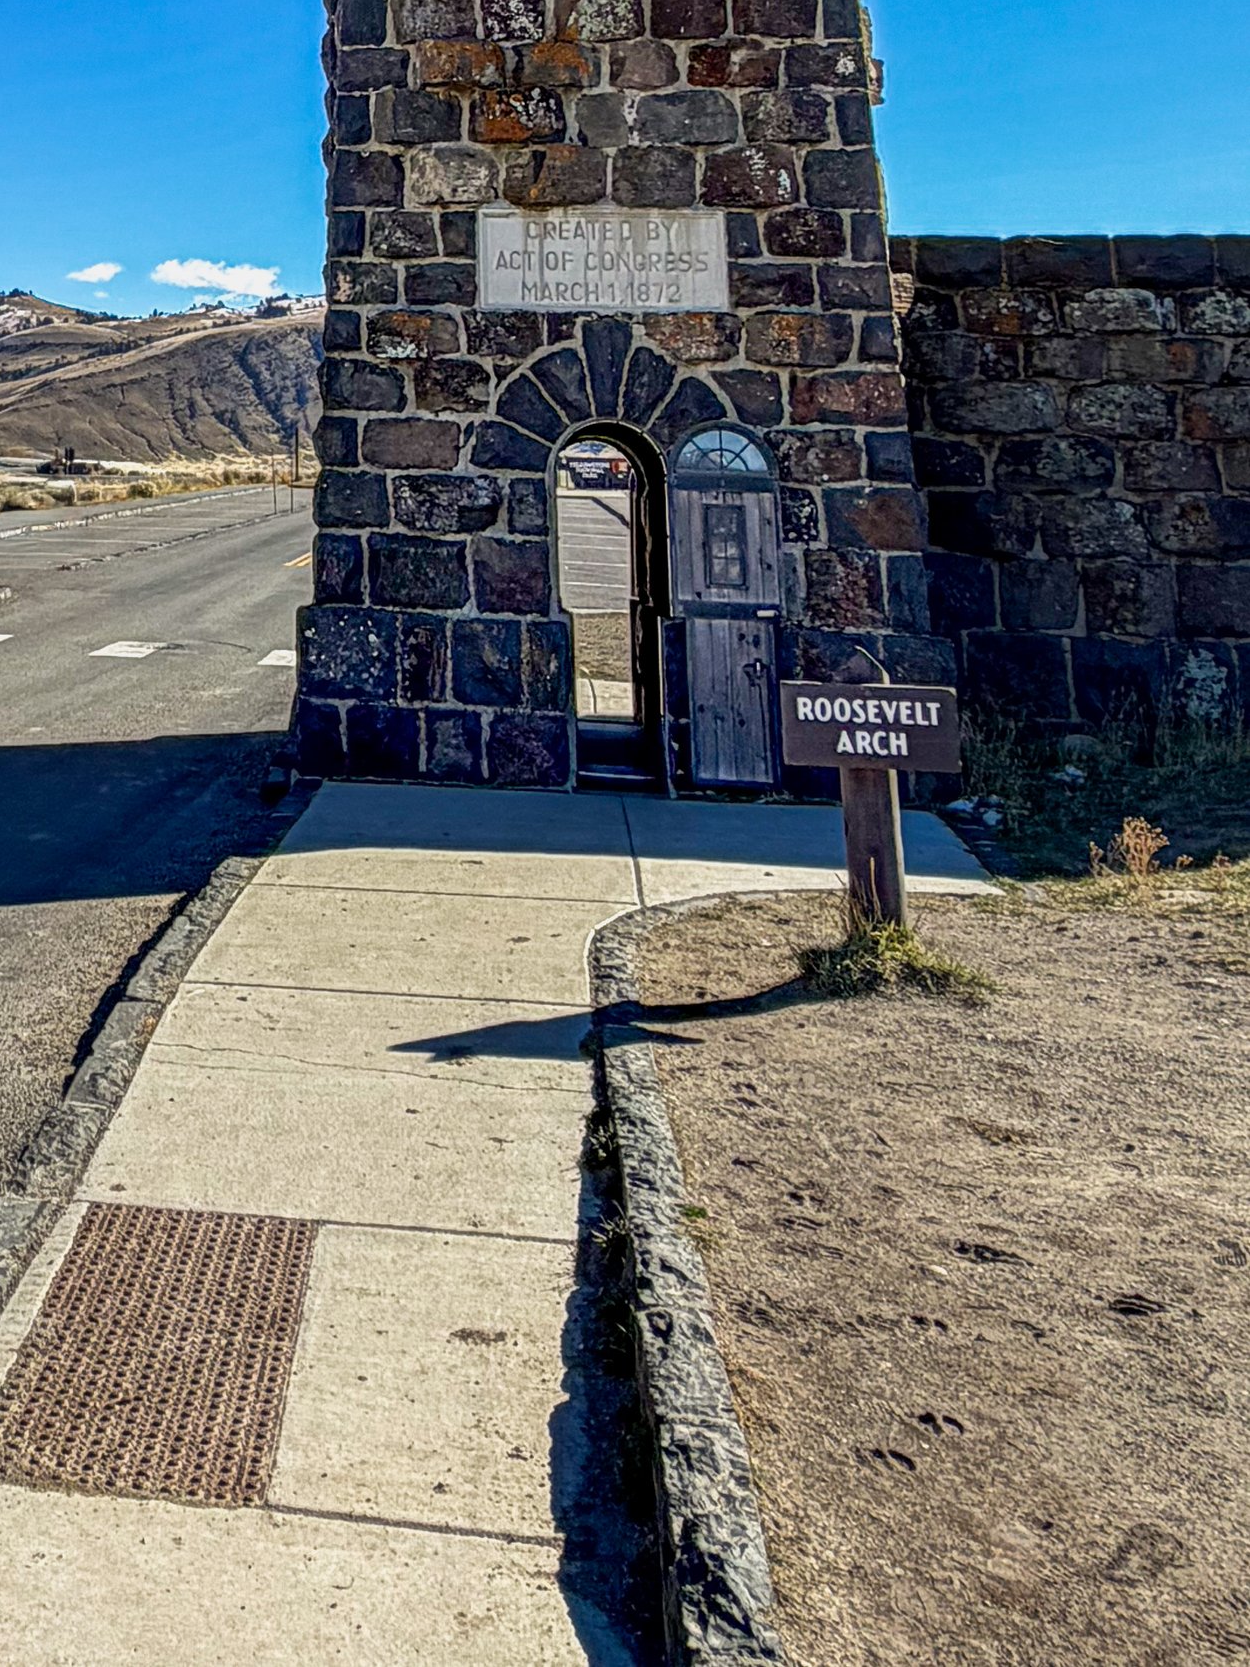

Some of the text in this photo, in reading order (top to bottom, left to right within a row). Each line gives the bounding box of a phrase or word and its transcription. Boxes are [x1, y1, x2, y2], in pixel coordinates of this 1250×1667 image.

[526, 220, 678, 241] CREATED BY
[495, 251, 709, 272] ACT OF CONGRESS
[521, 282, 599, 303] MARCH
[796, 697, 941, 726] ROOSEVELT
[836, 730, 909, 756] ARCH
